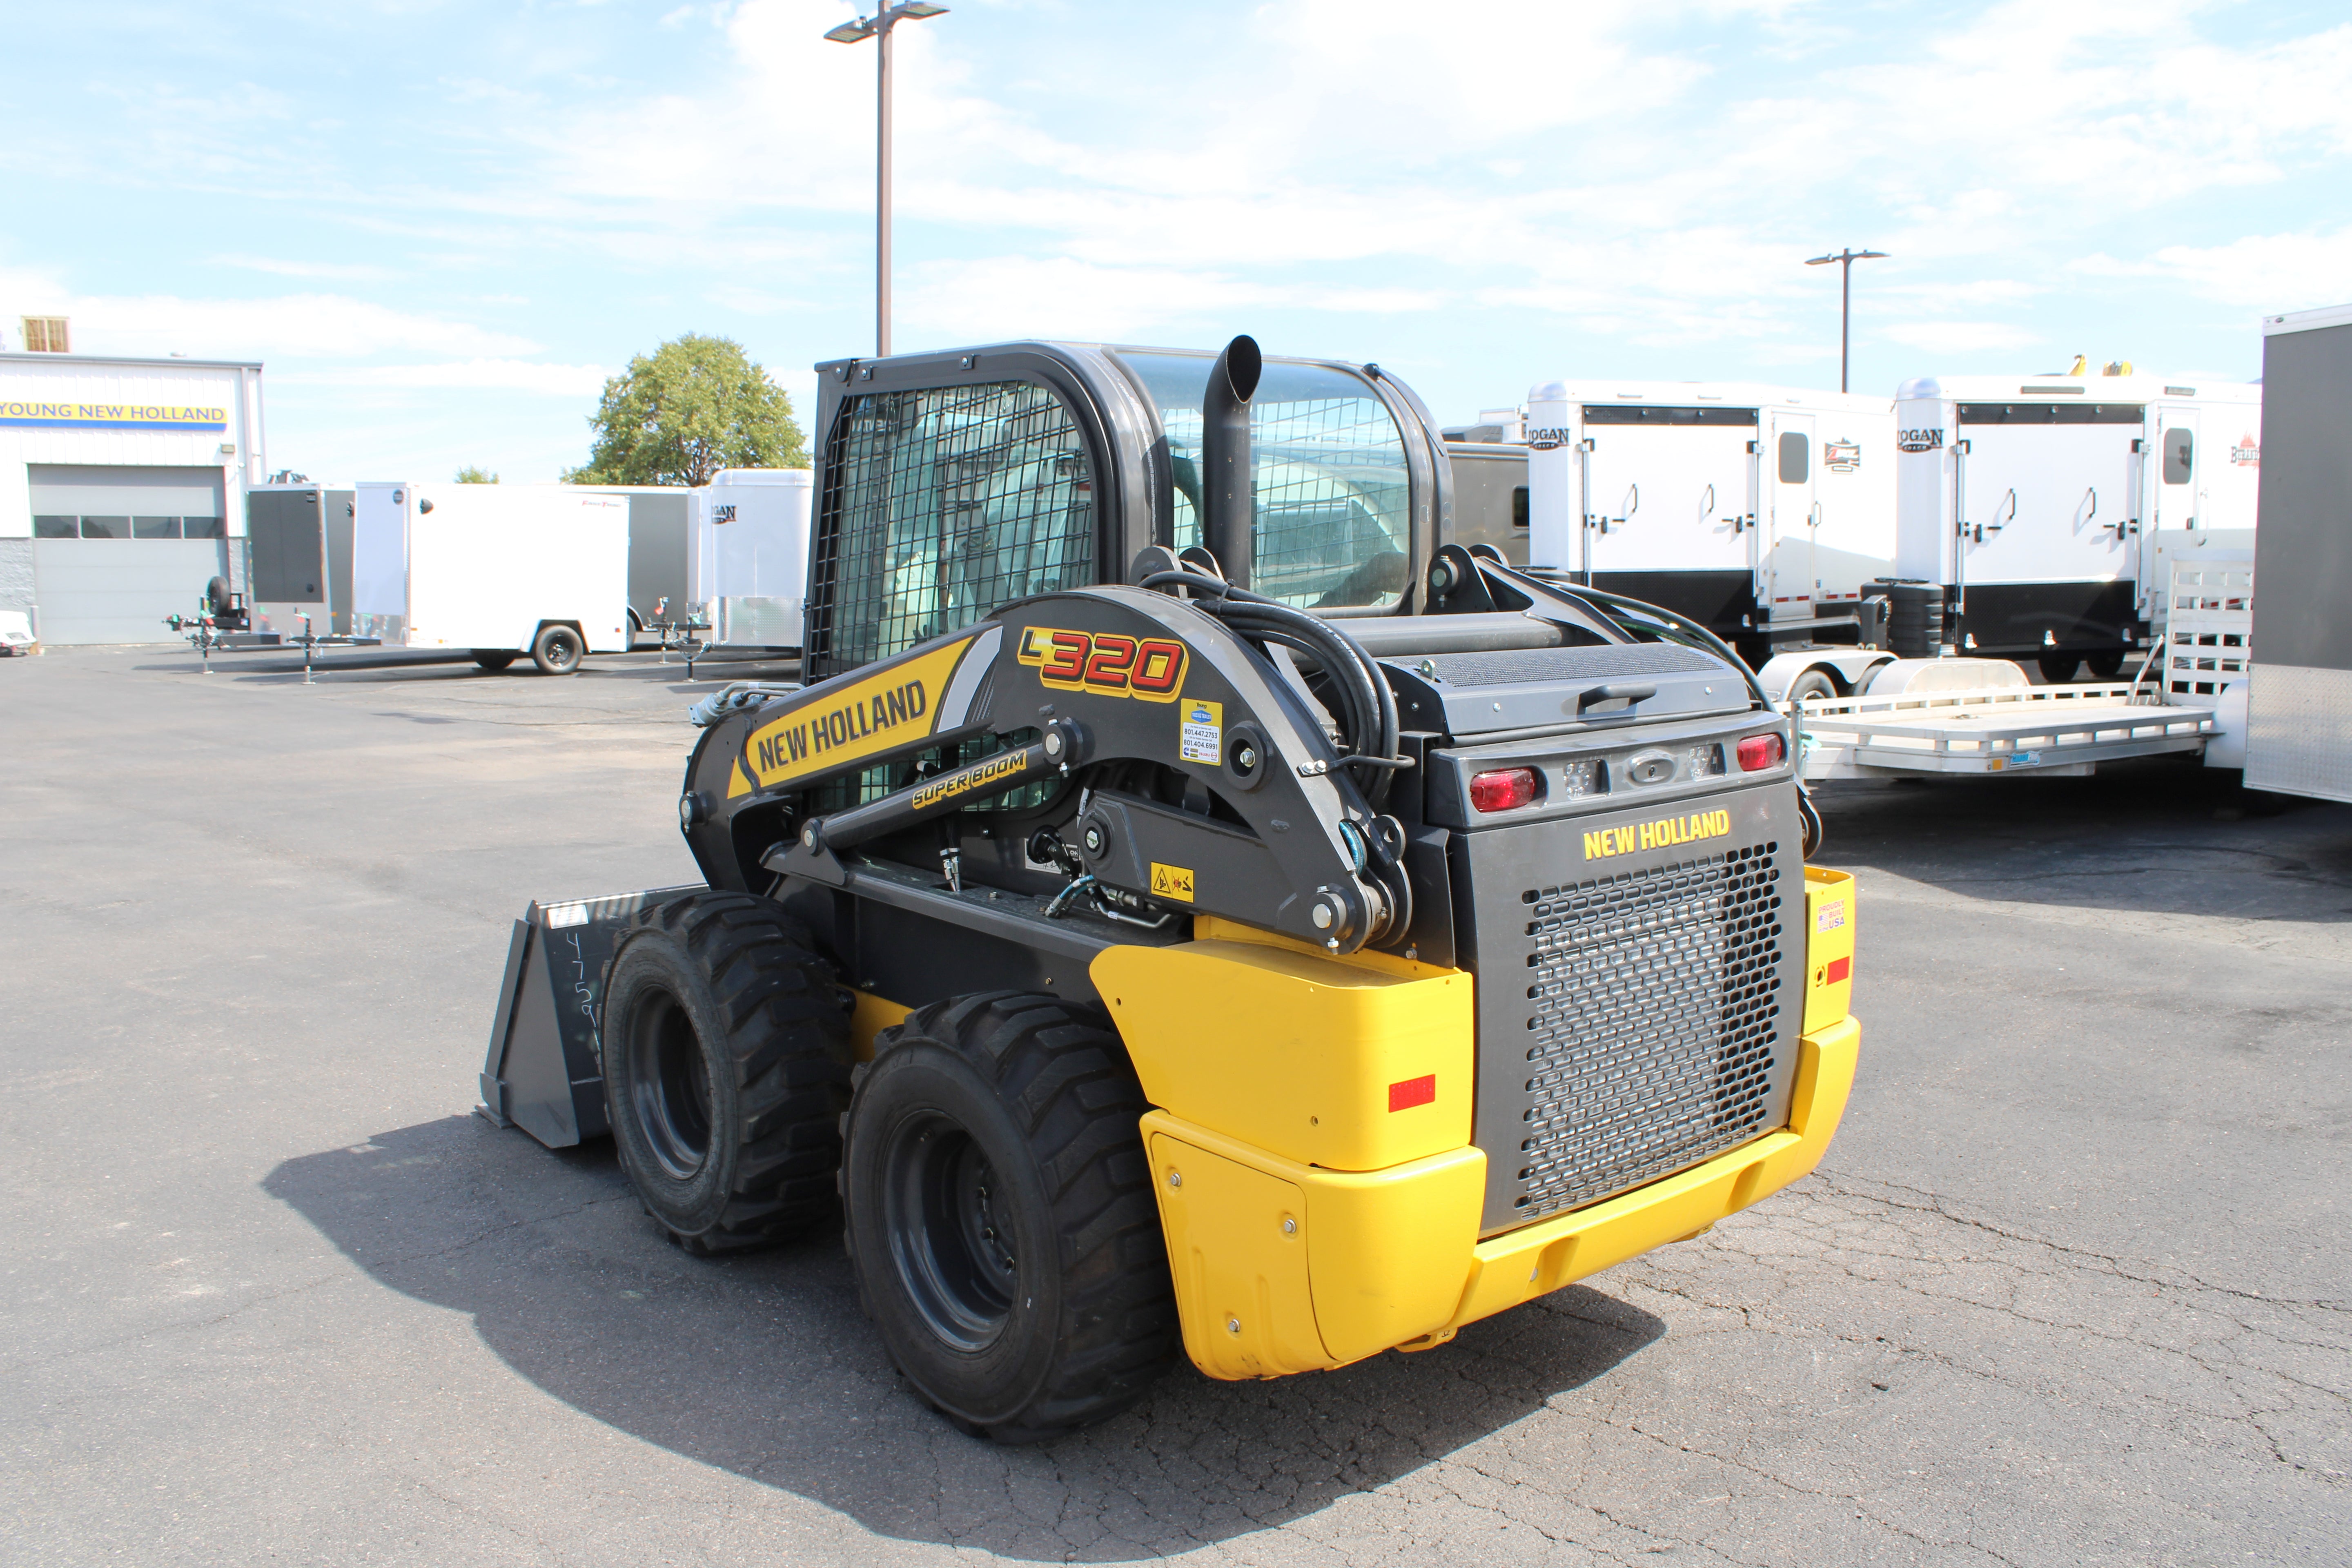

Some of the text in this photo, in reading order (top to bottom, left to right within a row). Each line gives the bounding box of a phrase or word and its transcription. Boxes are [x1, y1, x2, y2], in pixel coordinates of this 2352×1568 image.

[0, 402, 225, 421] YOUNG NEW HOLLAND
[1528, 428, 1570, 445] LOGAN
[713, 506, 737, 519] GAN
[1018, 628, 1187, 700] L320
[757, 679, 927, 773] NEW HOLLAND
[1184, 728, 1218, 739] 801.447.2753
[1184, 739, 1218, 750] 801.404.6991
[913, 748, 1027, 809] SUPER BOOM
[1584, 809, 1730, 860] NEW HOLLAND
[1819, 899, 1845, 914] PROUDLY
[1829, 907, 1845, 918] BUILT
[1829, 916, 1844, 929] USA
